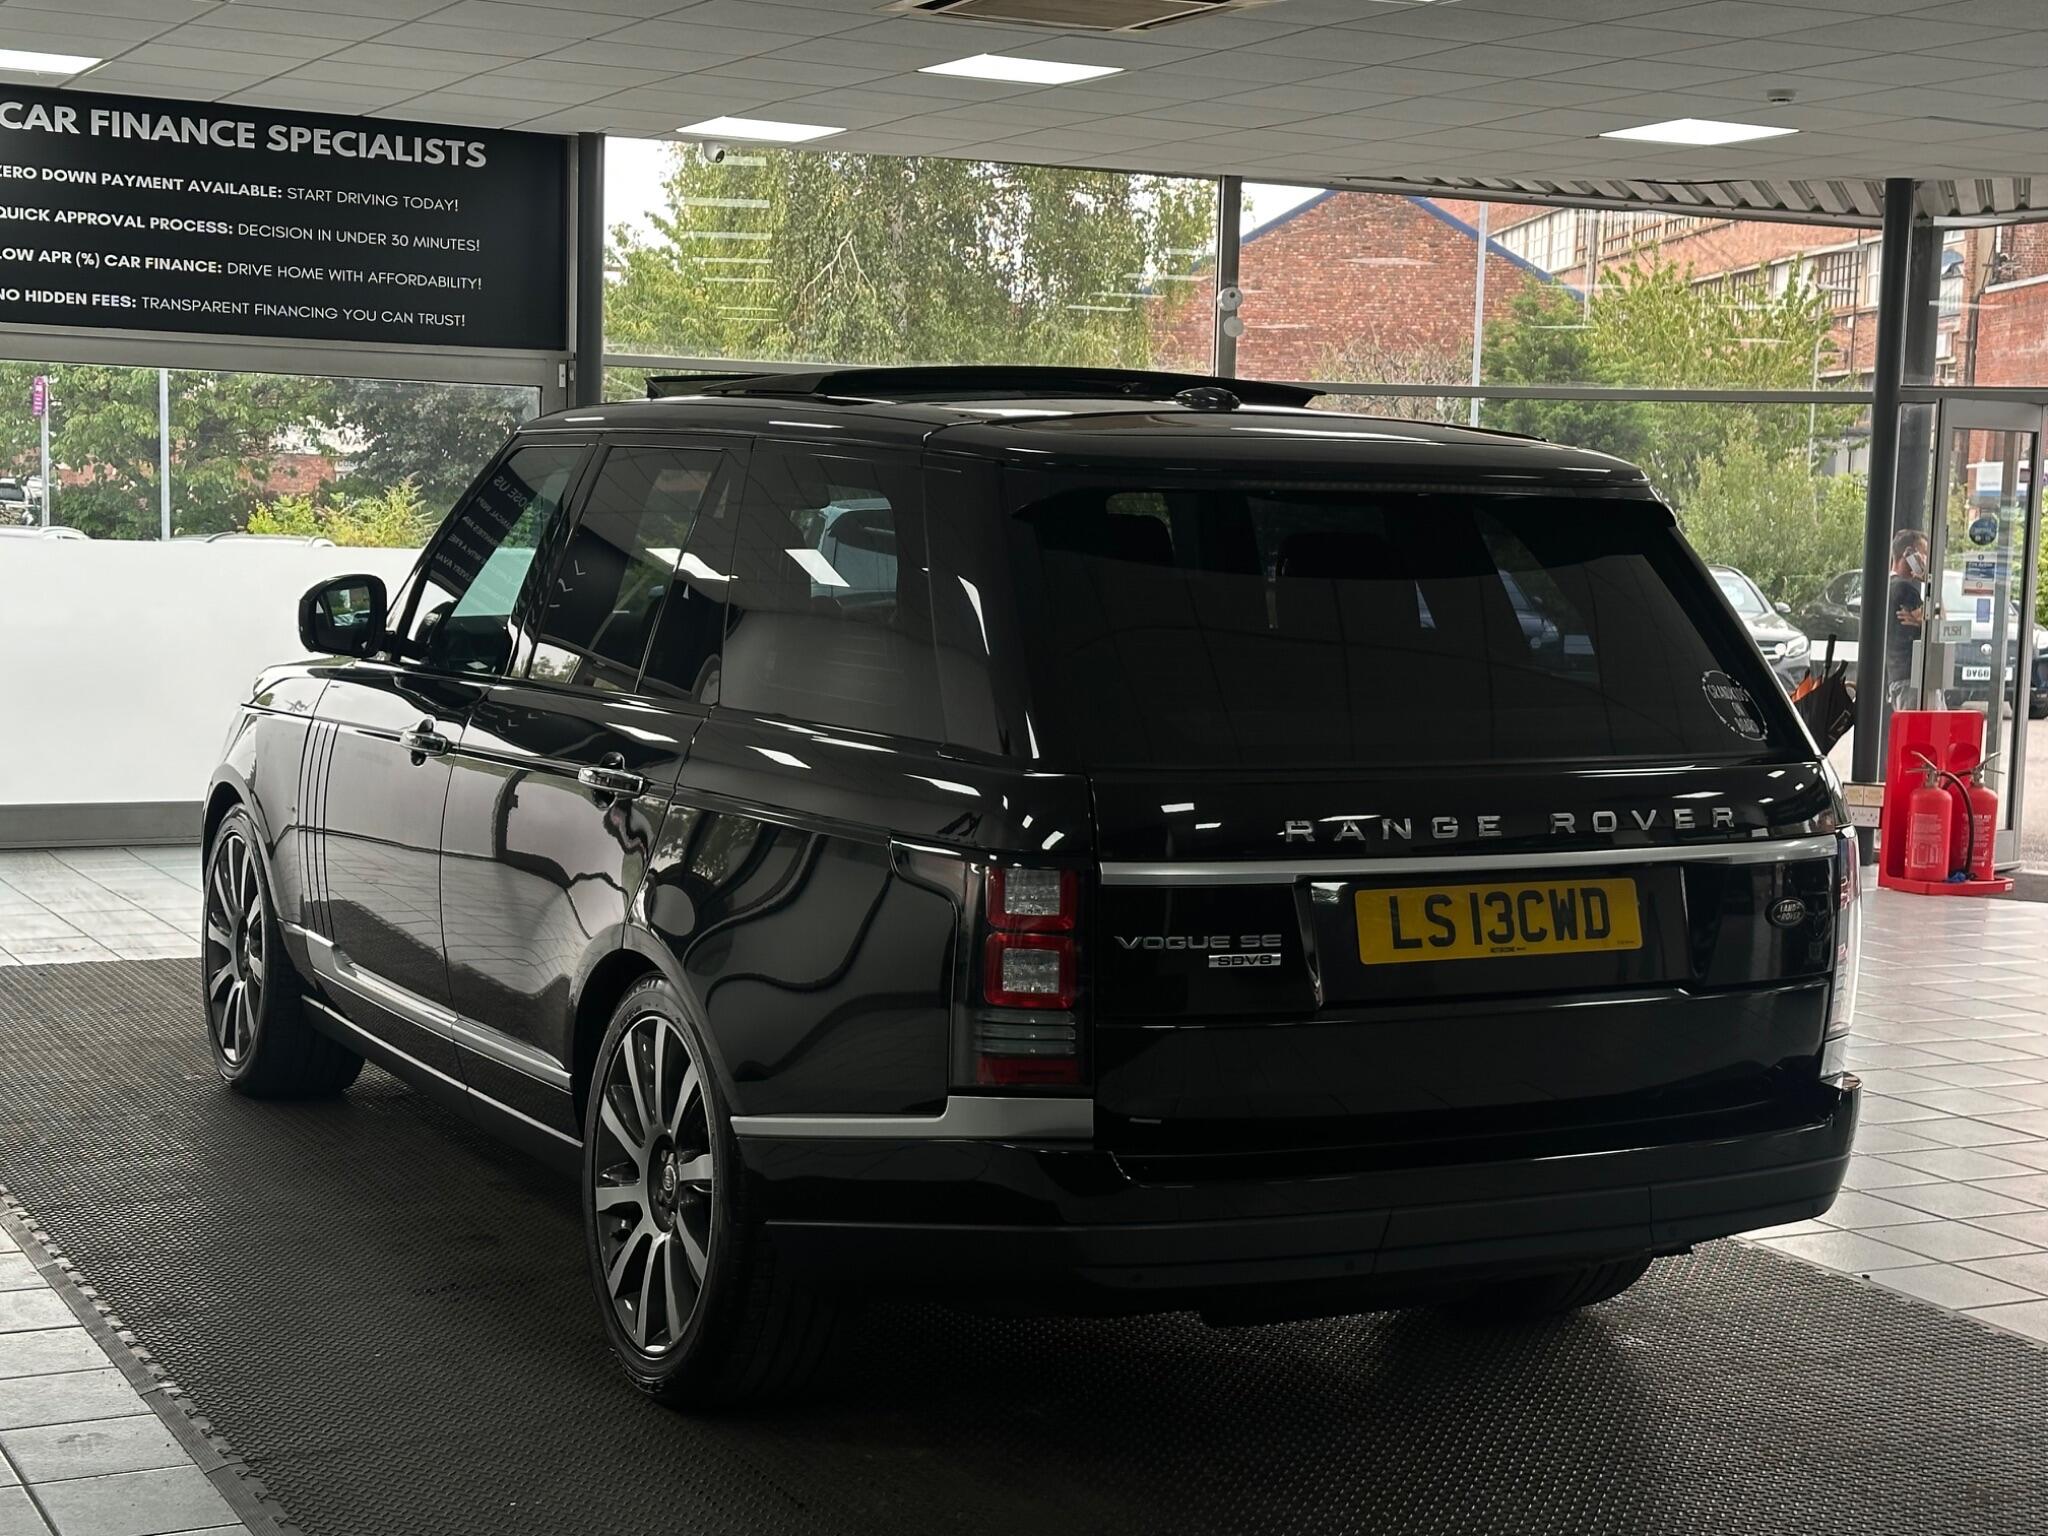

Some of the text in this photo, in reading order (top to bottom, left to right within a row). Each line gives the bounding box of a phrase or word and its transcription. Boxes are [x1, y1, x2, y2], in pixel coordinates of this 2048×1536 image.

[0, 101, 486, 168] CAR FINANCE SPECIALISTS
[0, 164, 458, 212] ERO DOWN PAYMENT AVAILABLE: START DRIVING TODAY!
[54, 210, 146, 229] APPROVAL
[150, 217, 233, 235] PROCESS:
[238, 223, 313, 240] DECISION
[318, 229, 331, 242] IN
[336, 230, 387, 245] UNDER
[391, 234, 409, 247] 30
[413, 236, 480, 252] MINUTES!
[0, 247, 482, 290] OW APR (%) CAR FINANCE: DRIVE HOME WITH AFFORDABILITY!
[25, 289, 87, 305] HIDDEN
[92, 293, 137, 308] FEES:
[141, 296, 250, 314] TRANSPARENT
[254, 303, 338, 319] FINANCING
[342, 308, 377, 322] YOU
[381, 311, 413, 324] CAN
[417, 313, 465, 327] TRUST!
[1943, 626, 1962, 637] PUSH
[1285, 807, 1735, 842] RANGE ROVER
[1113, 934, 1282, 950] VOGUE SE
[1218, 955, 1272, 966] SDV8
